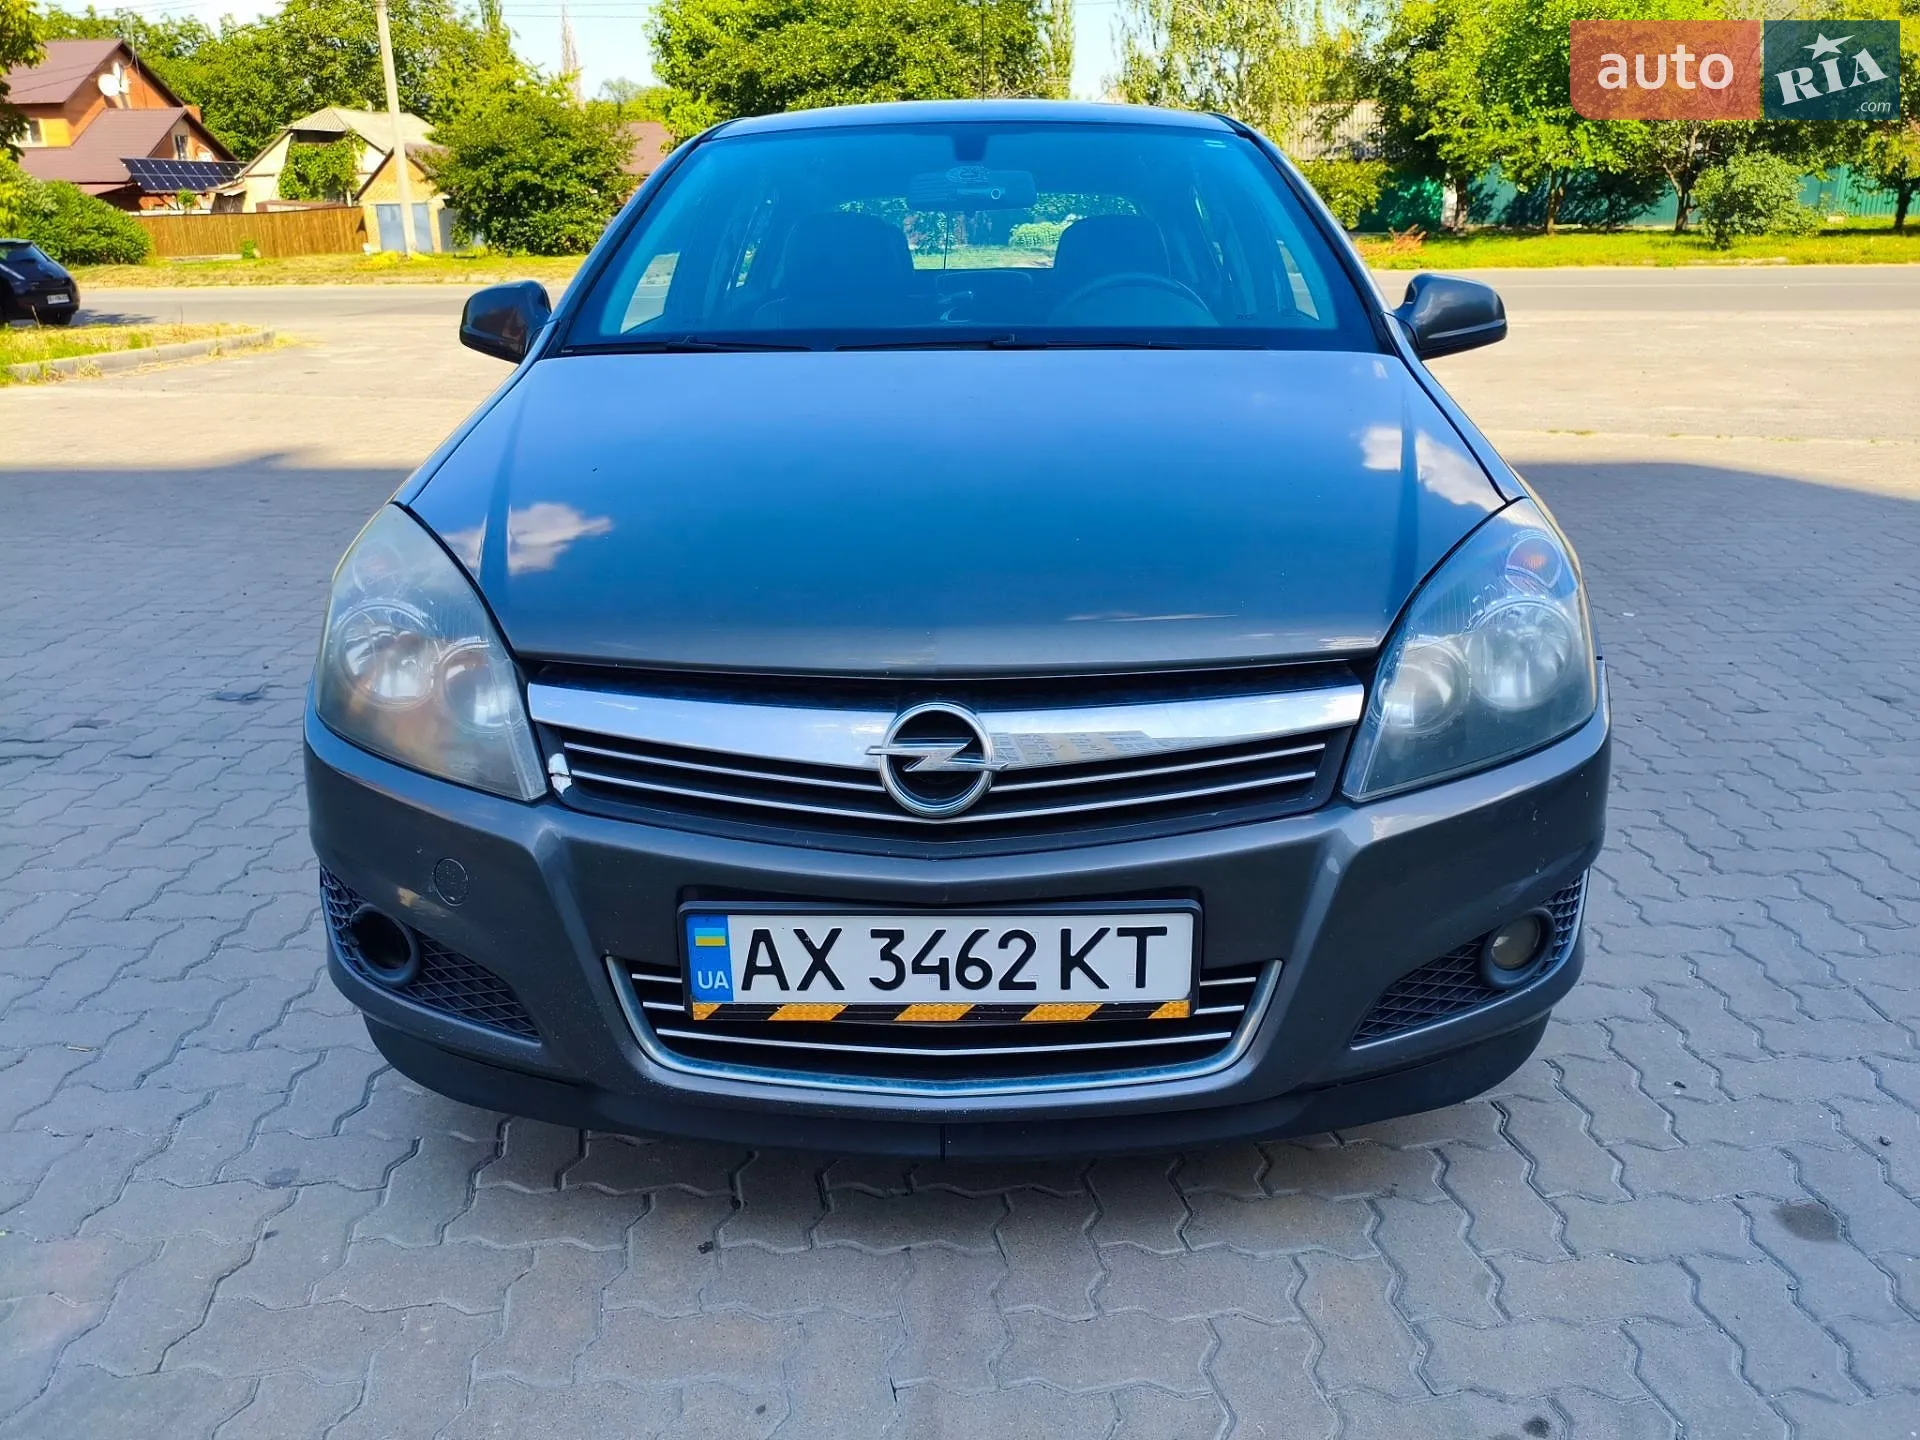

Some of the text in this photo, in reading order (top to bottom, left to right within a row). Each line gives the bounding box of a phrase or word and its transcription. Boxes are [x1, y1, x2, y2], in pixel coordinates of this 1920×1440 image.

[740, 926, 1168, 991] AX 3462 KT
[698, 970, 730, 990] UA
